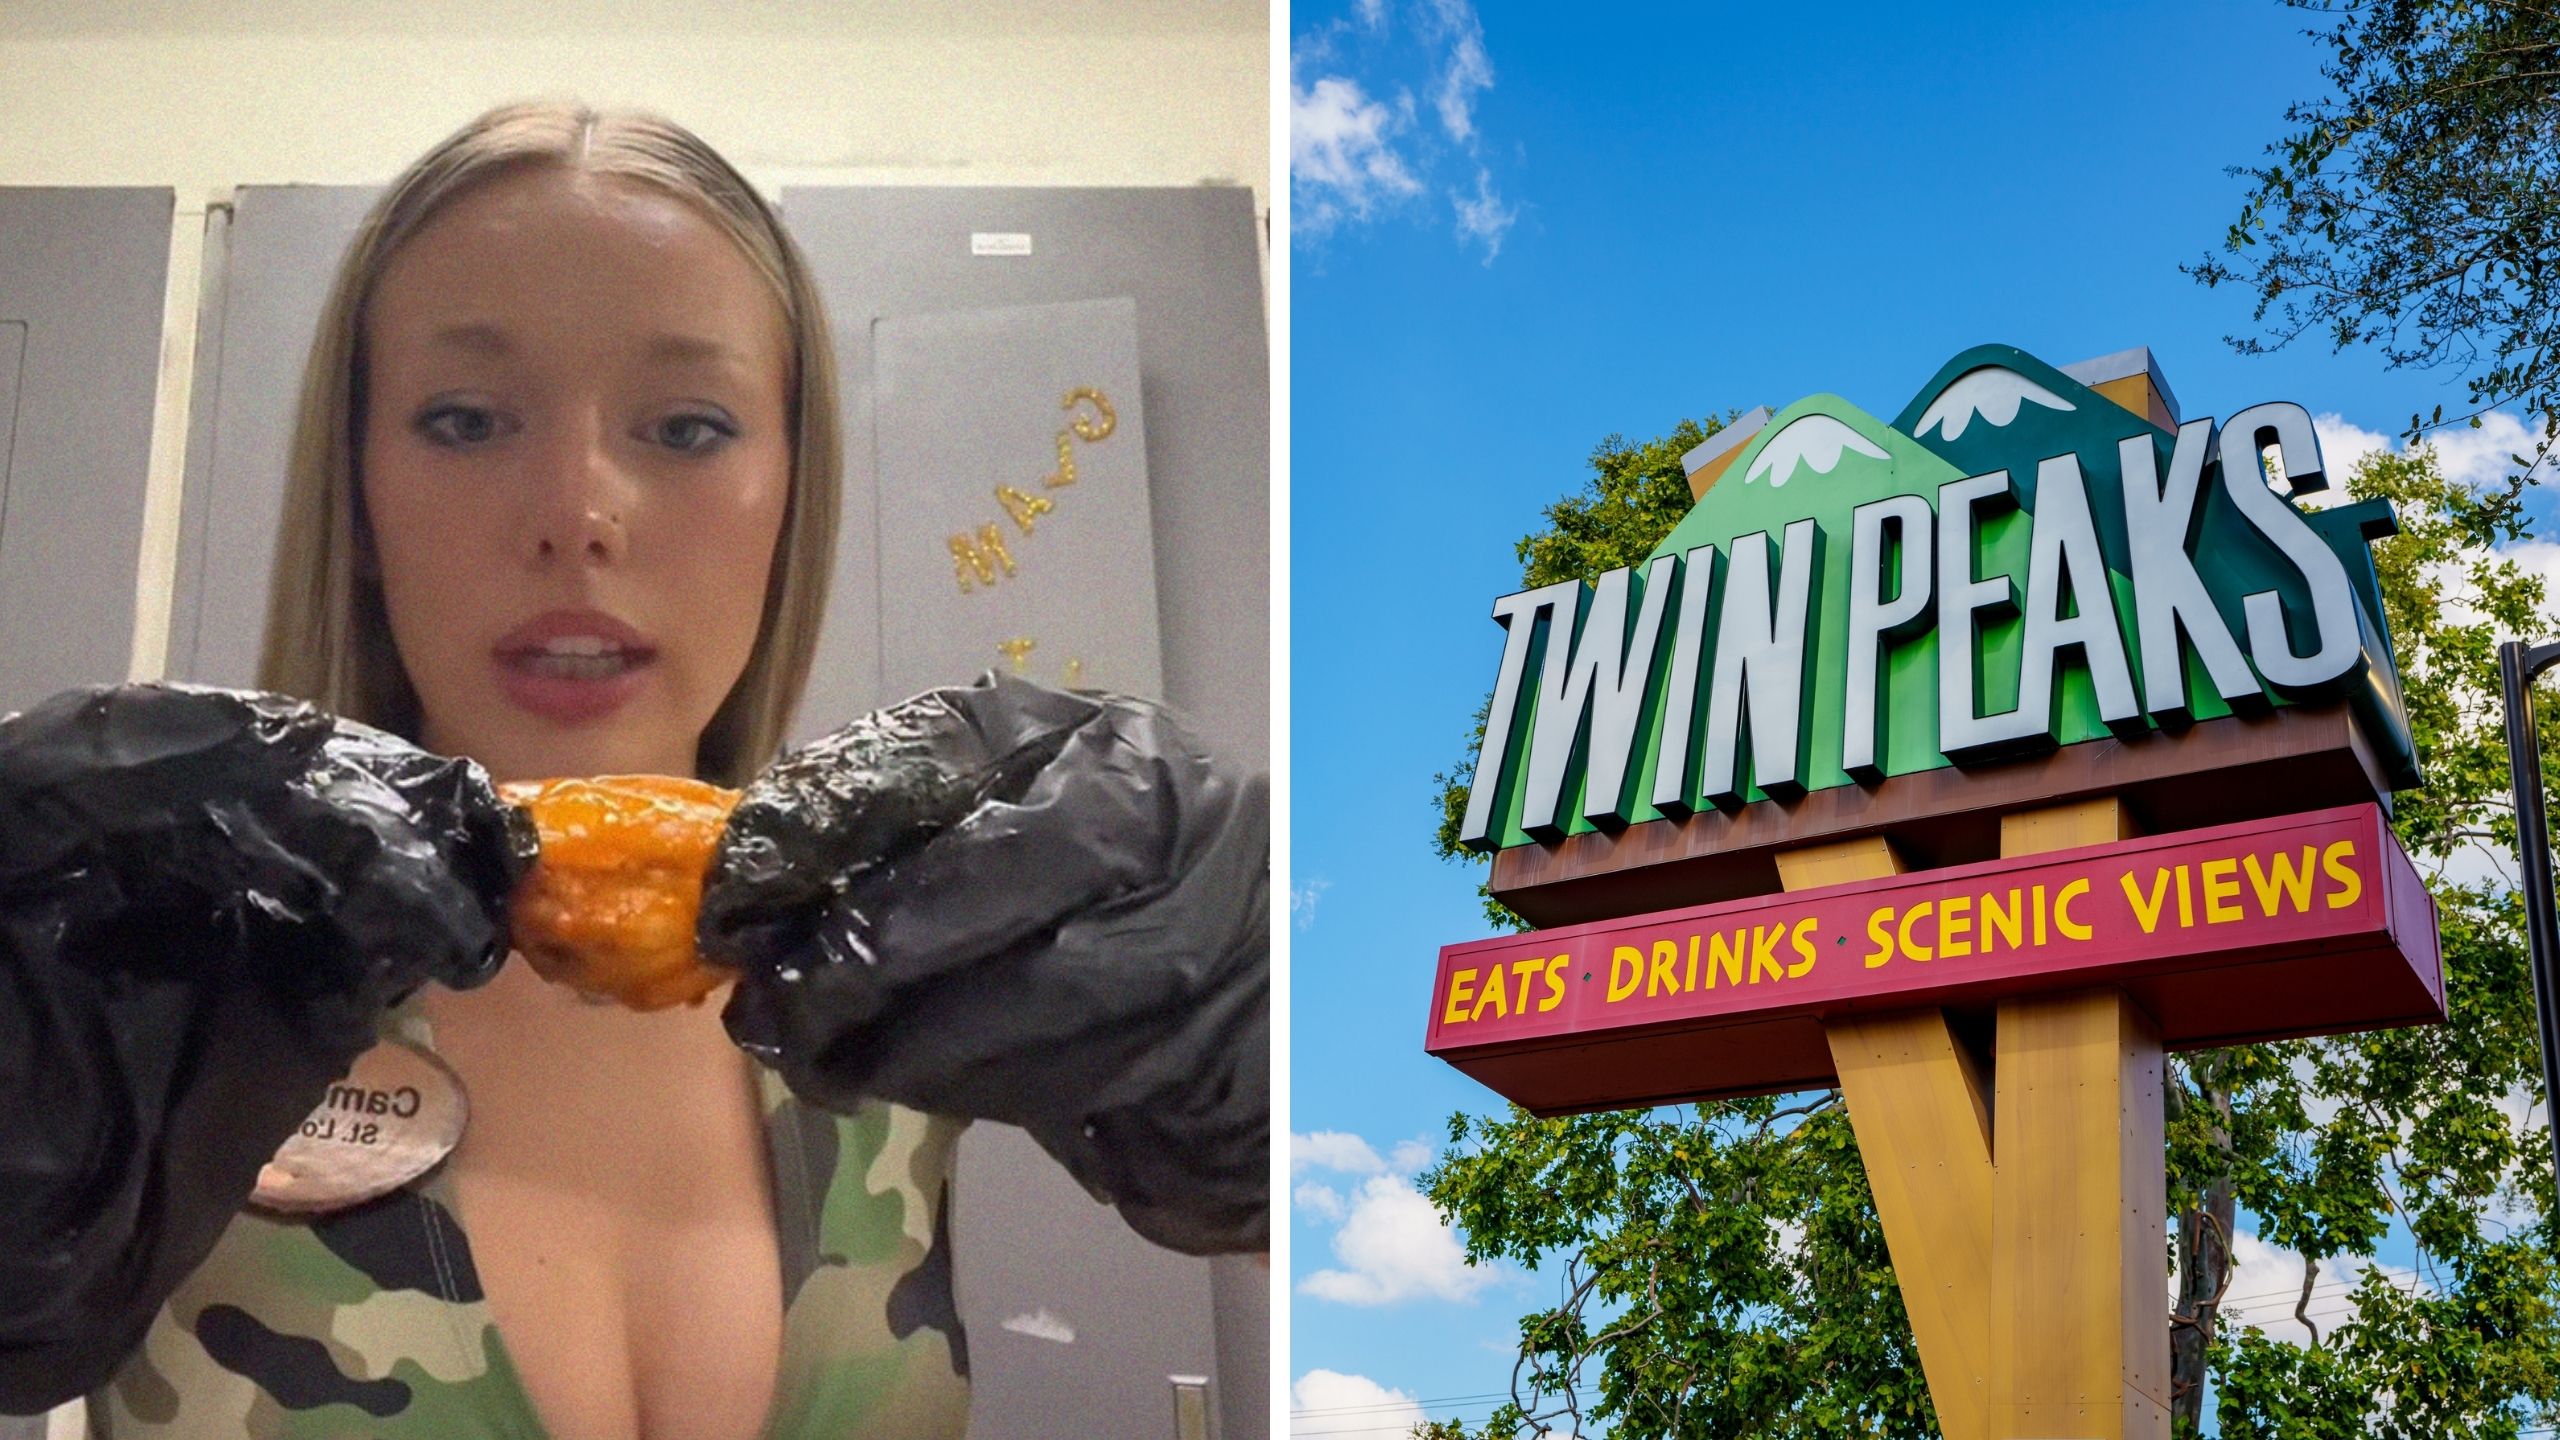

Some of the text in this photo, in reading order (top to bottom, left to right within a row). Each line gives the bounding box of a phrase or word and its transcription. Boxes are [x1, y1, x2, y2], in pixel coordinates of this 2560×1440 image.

[1459, 400, 2368, 850] TWIN PEAKS
[1443, 840, 2363, 1025] EATS DRINKS SCENIC VIEWS
